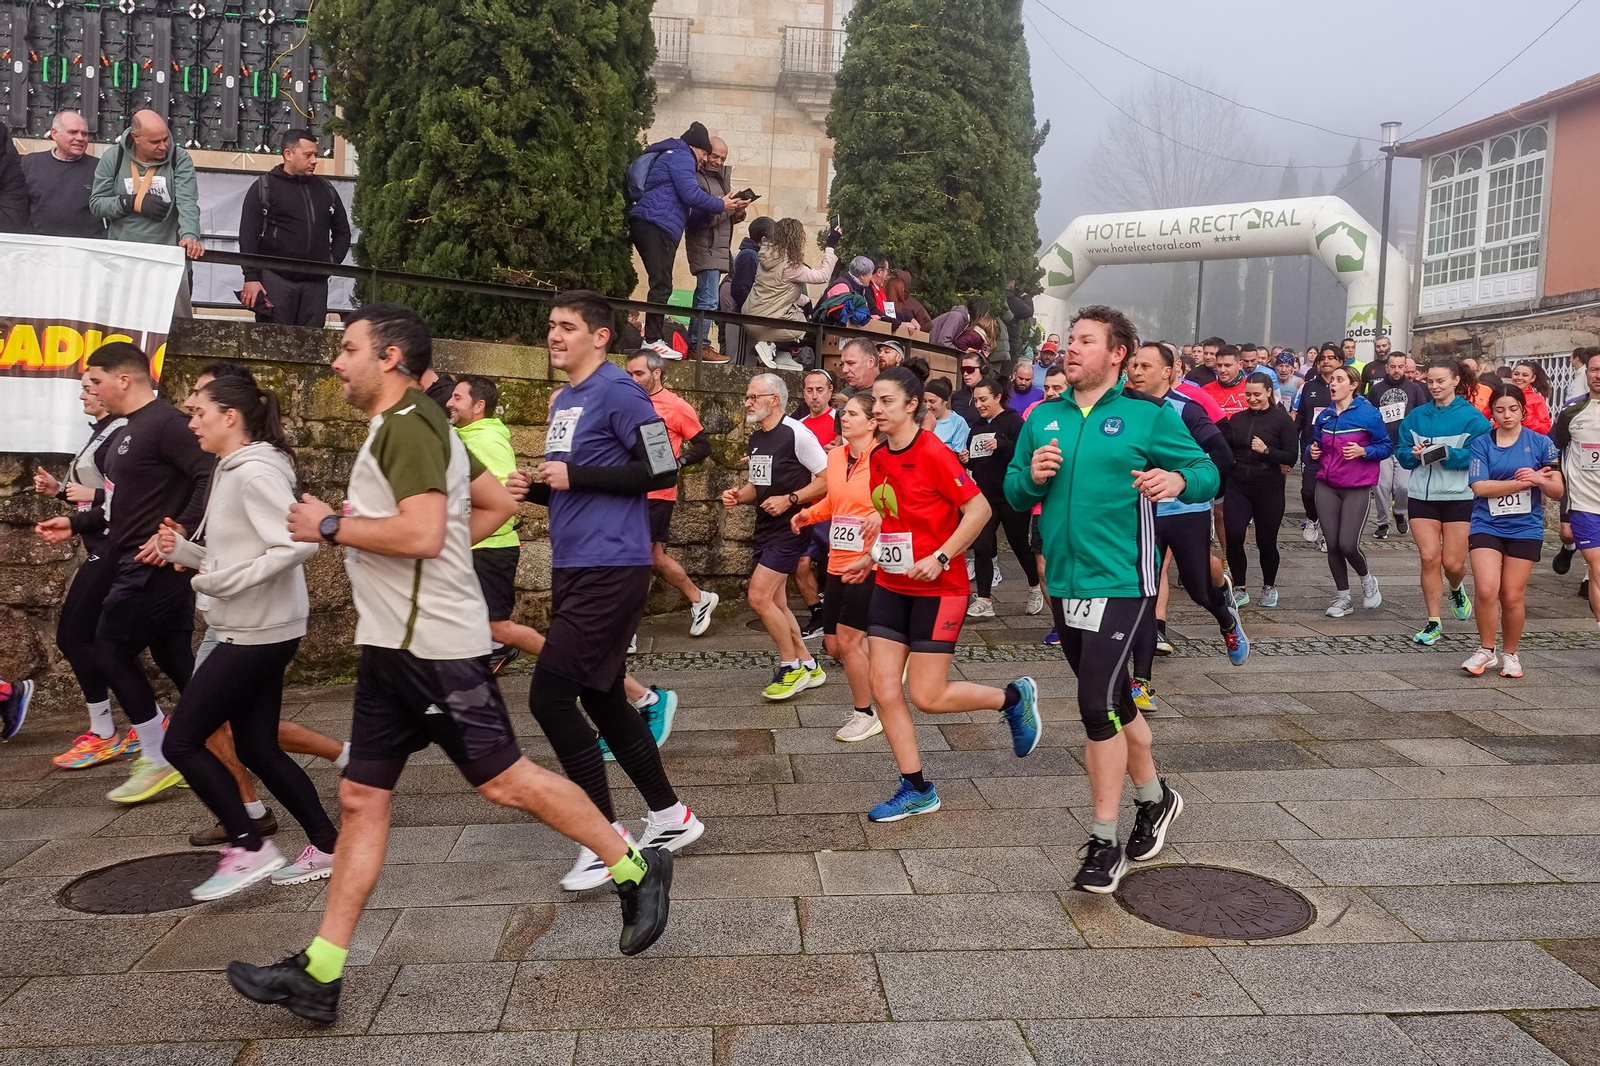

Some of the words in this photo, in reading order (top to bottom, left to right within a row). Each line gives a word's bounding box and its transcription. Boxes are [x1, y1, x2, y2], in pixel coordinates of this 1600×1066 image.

[1086, 221, 1147, 241] HOTEL
[1159, 219, 1182, 237] LA
[1086, 238, 1202, 254] www.hotelrectoral.com
[0, 323, 134, 374] ADI
[1385, 408, 1402, 419] 512
[974, 440, 987, 452] 63
[752, 464, 766, 478] 561
[1496, 493, 1522, 508] 201
[833, 526, 855, 542] 226
[878, 546, 902, 563] 230
